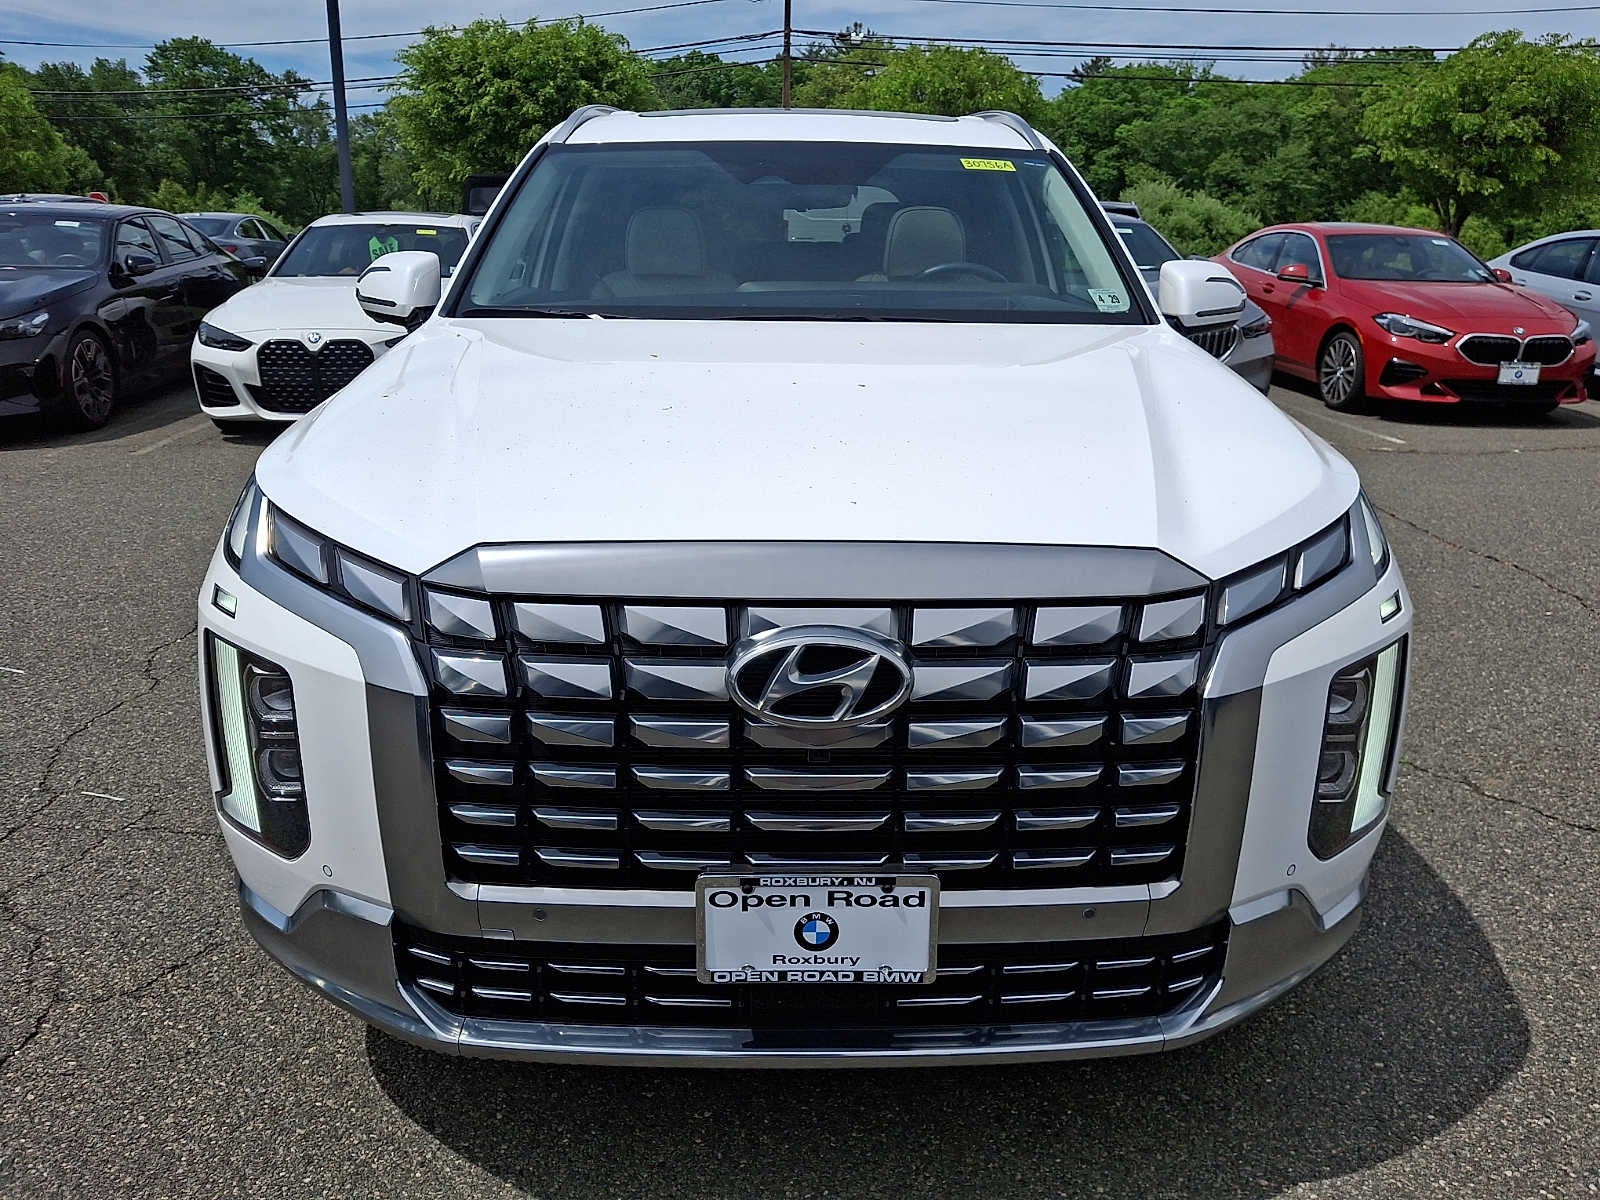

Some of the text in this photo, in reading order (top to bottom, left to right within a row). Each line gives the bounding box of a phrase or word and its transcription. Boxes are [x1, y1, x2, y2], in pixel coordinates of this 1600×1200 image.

[1097, 294, 1120, 304] 4 29
[854, 877, 876, 886] NJ
[708, 890, 926, 912] Open Road
[800, 913, 835, 925] BMW
[772, 954, 861, 967] Roxbury
[713, 971, 922, 983] OPEN ROAD BMW
